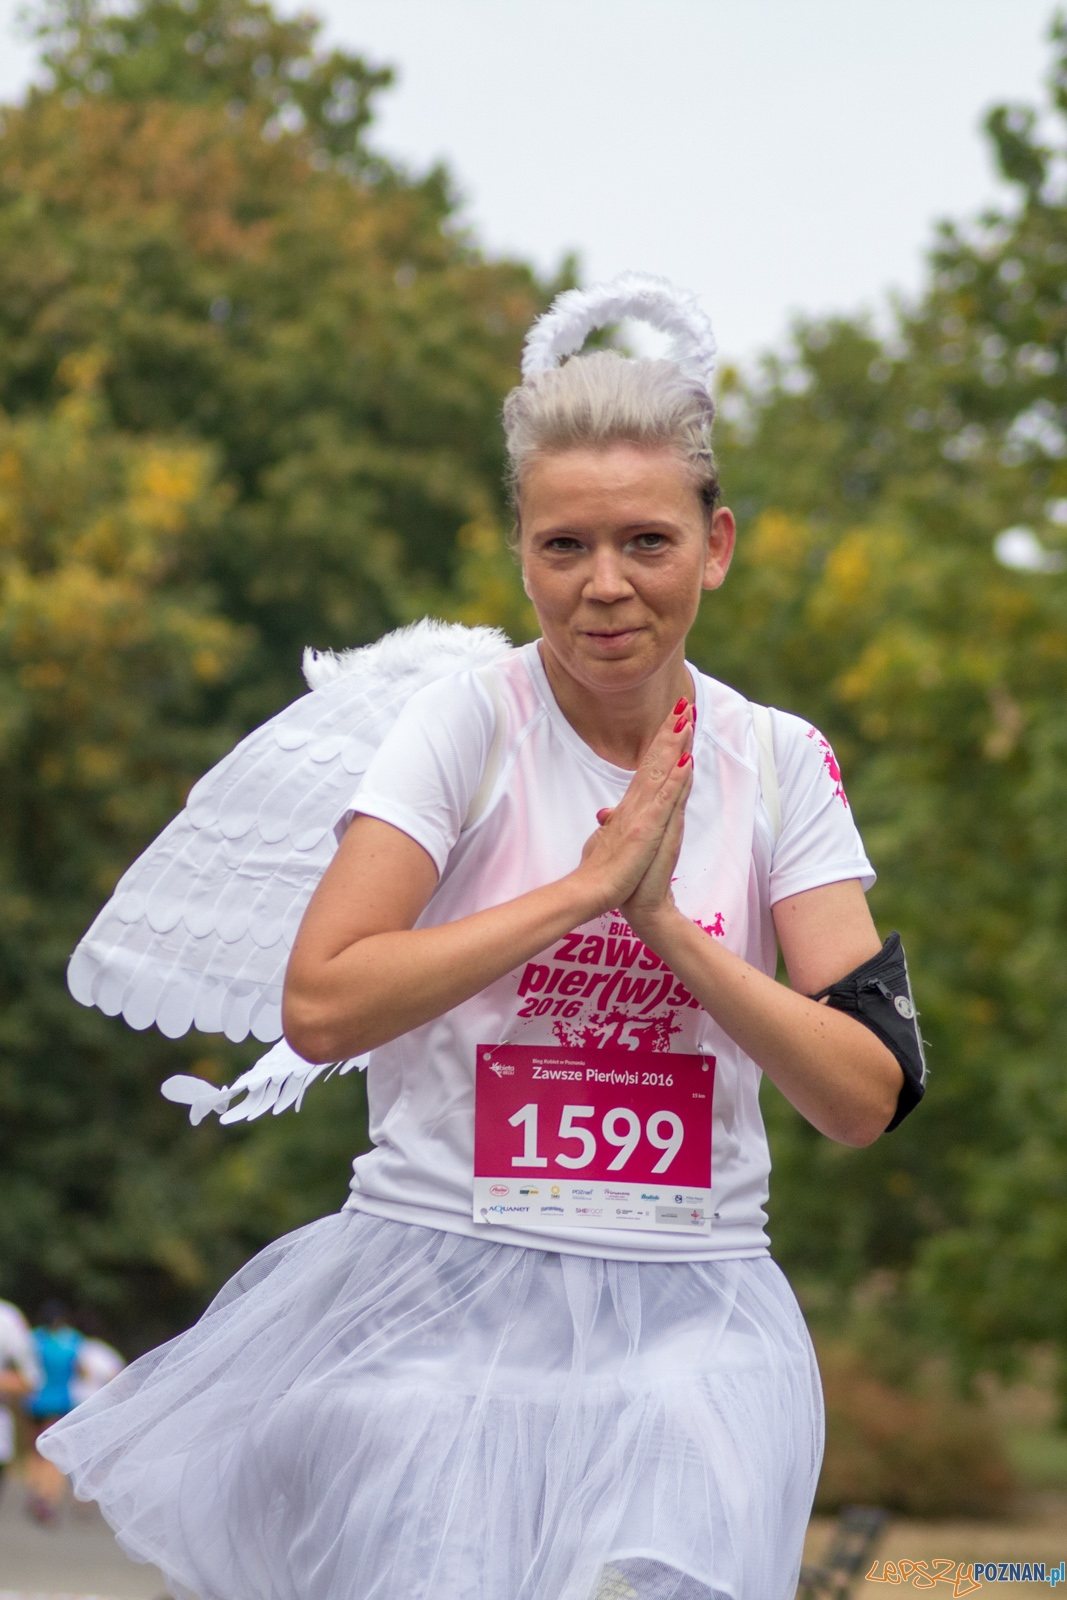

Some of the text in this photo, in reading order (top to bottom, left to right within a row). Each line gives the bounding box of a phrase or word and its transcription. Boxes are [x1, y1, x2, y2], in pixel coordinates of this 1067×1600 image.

[553, 933, 672, 972] zaws
[517, 997, 584, 1018] 2016
[532, 1066, 674, 1087] Zawsze Pier(w)si 2016
[508, 1103, 684, 1174] 1599
